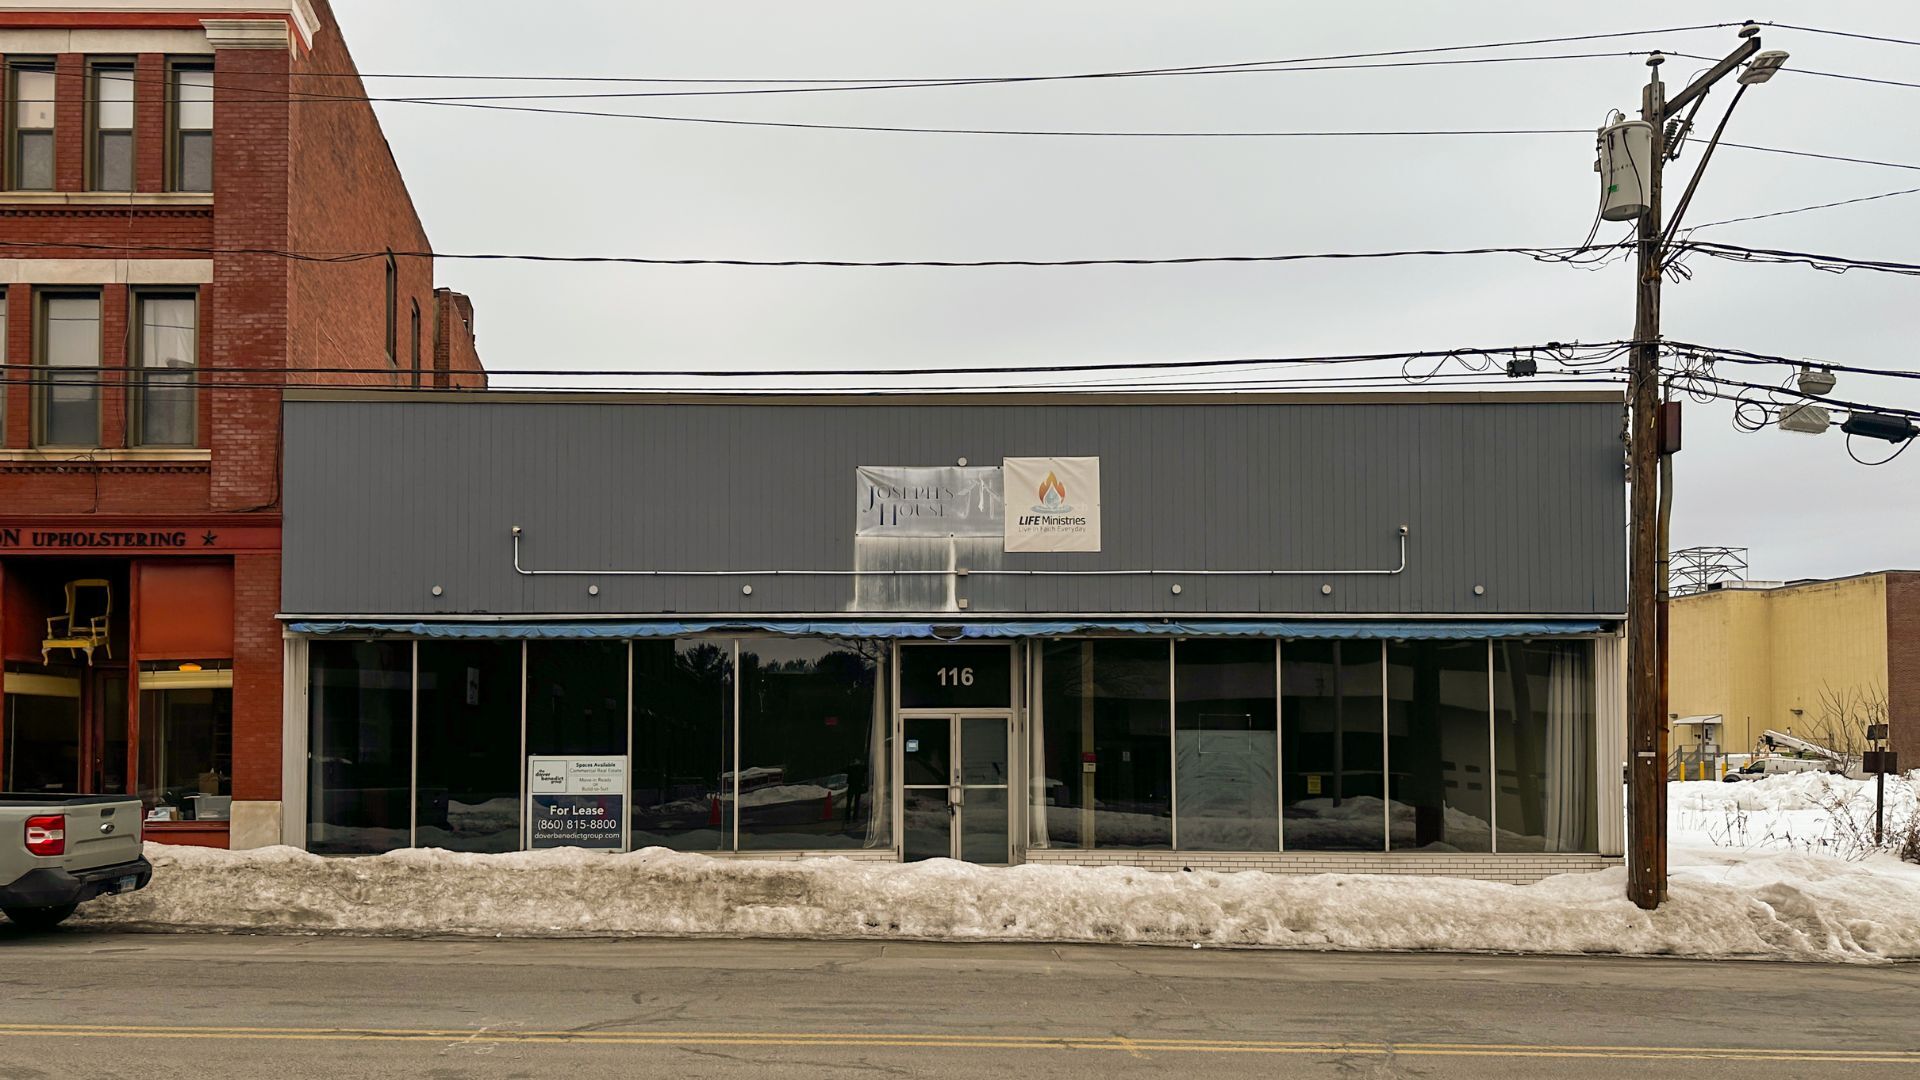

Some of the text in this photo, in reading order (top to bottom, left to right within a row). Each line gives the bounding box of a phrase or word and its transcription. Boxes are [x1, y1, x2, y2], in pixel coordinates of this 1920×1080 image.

[1018, 515, 1086, 526] LIFE Ministries
[0, 528, 186, 547] N UPHOLSTERING
[937, 667, 974, 686] 116
[550, 805, 605, 816] For Lease
[537, 819, 617, 831] (860) 815-8800
[534, 832, 620, 841] doverbenedictgroup.com
